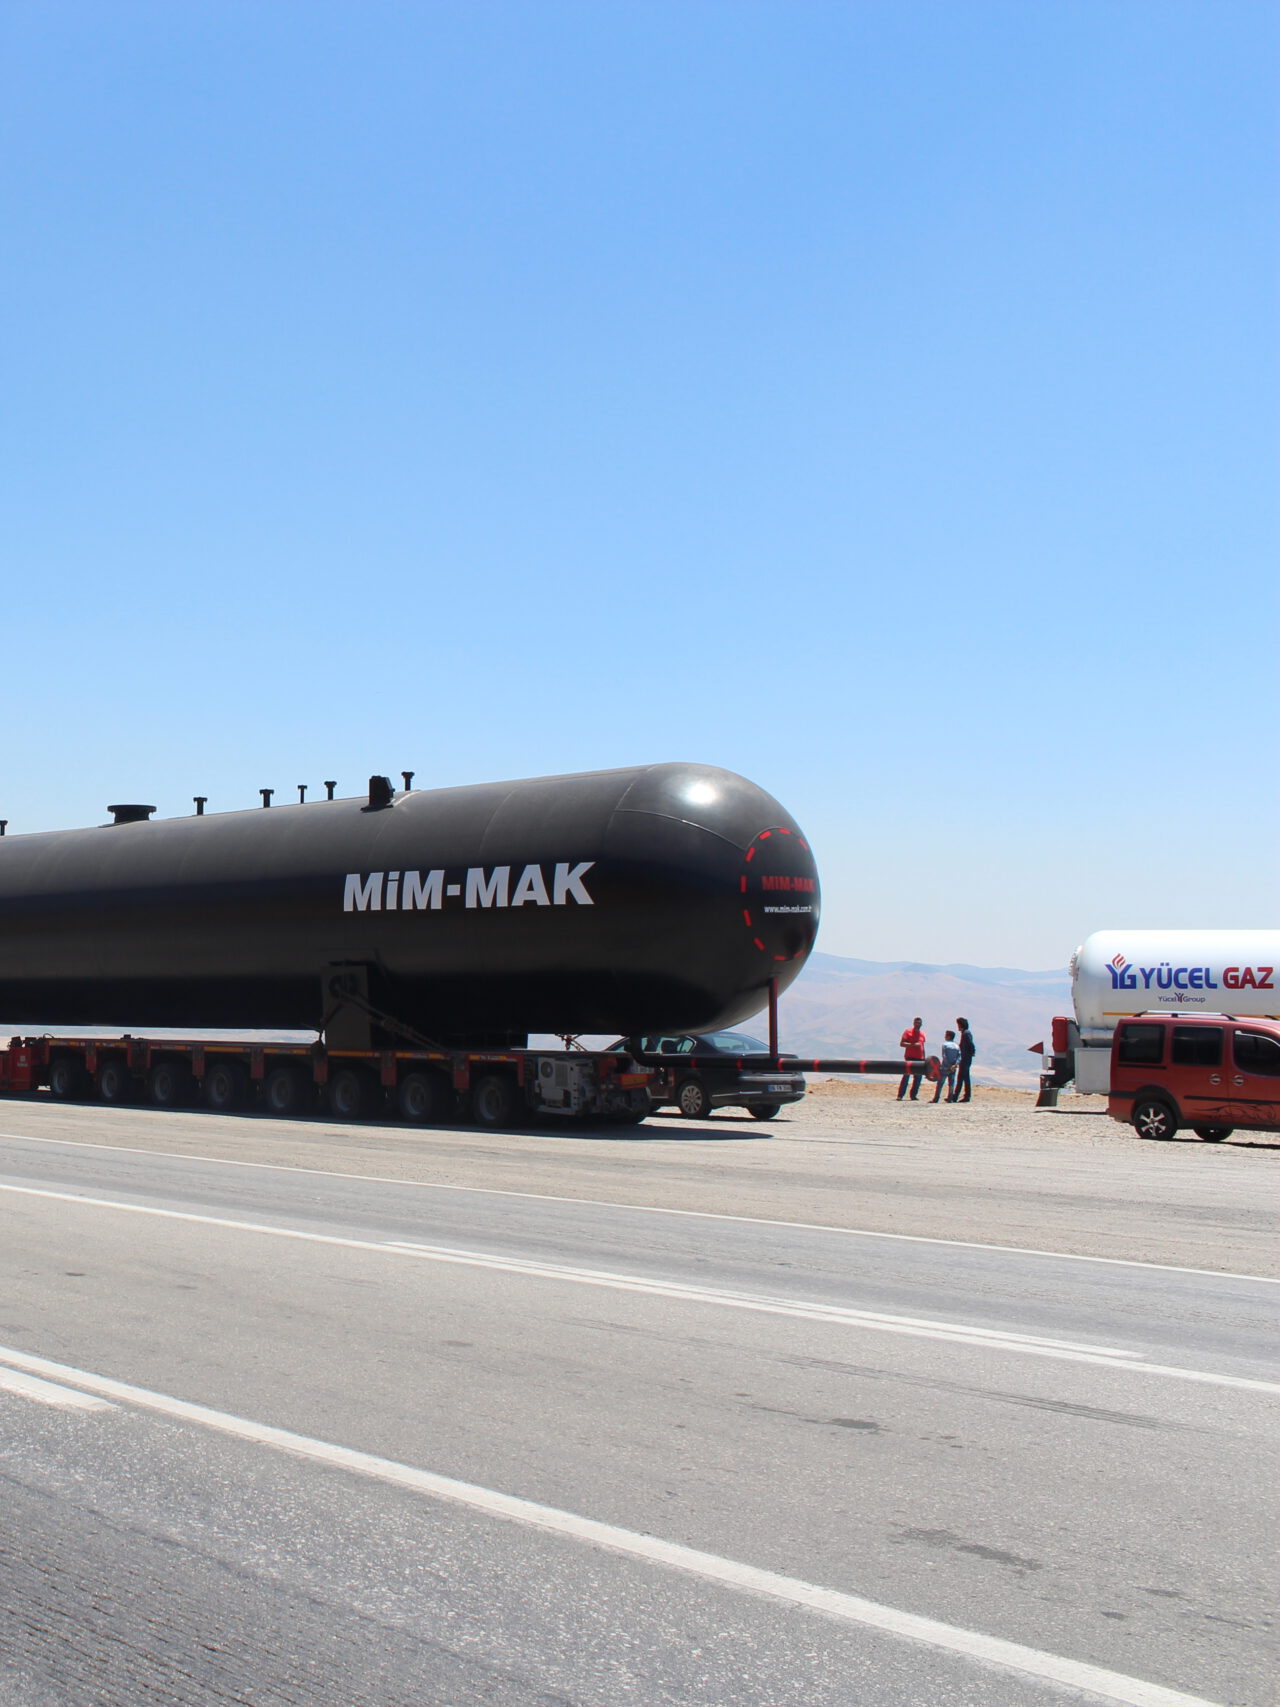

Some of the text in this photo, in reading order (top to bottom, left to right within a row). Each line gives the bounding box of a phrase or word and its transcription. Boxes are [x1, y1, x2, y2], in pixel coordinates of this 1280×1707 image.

[343, 861, 596, 912] MiM-MAK
[1139, 962, 1218, 990] YÜCEL
[1222, 966, 1274, 989] GAZ
